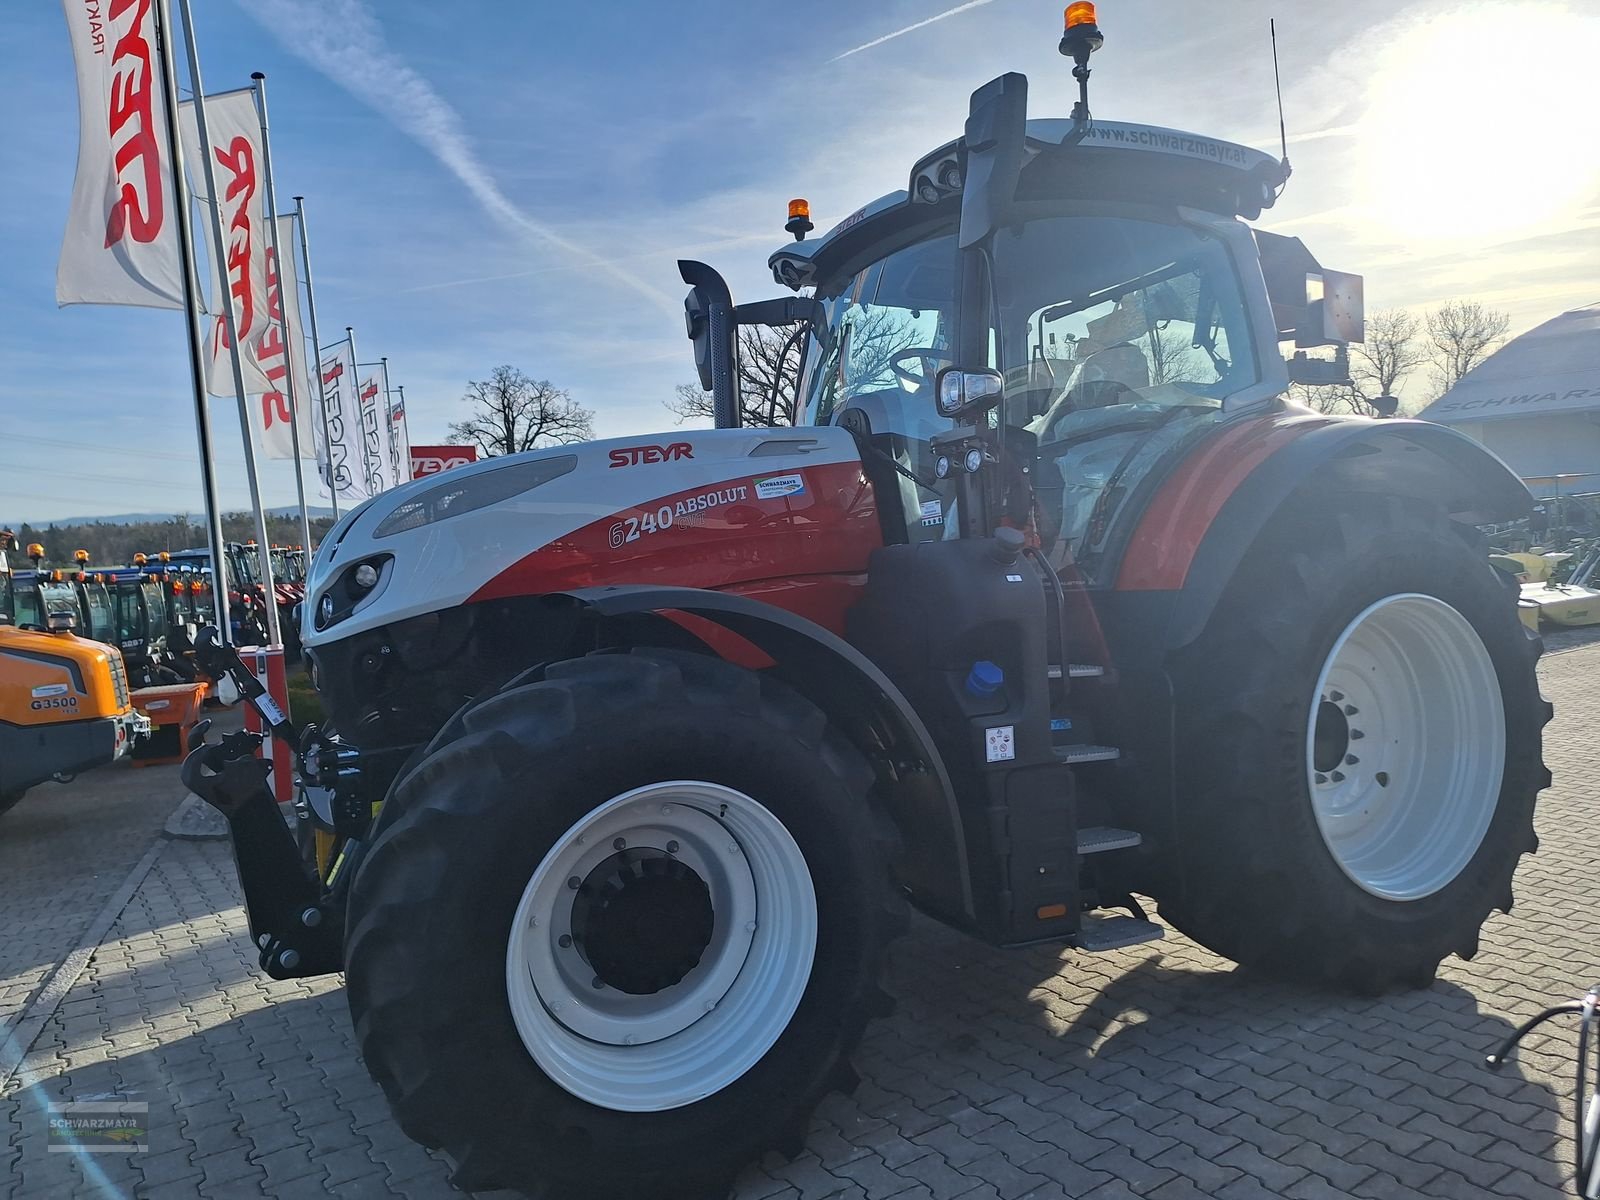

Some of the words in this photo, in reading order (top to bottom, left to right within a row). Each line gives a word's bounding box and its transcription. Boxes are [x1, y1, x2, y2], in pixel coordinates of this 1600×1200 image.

[608, 442, 695, 468] STEYR
[608, 505, 673, 549] 6240
[674, 486, 747, 517] ABSOLUT
[31, 697, 77, 710] G3500
